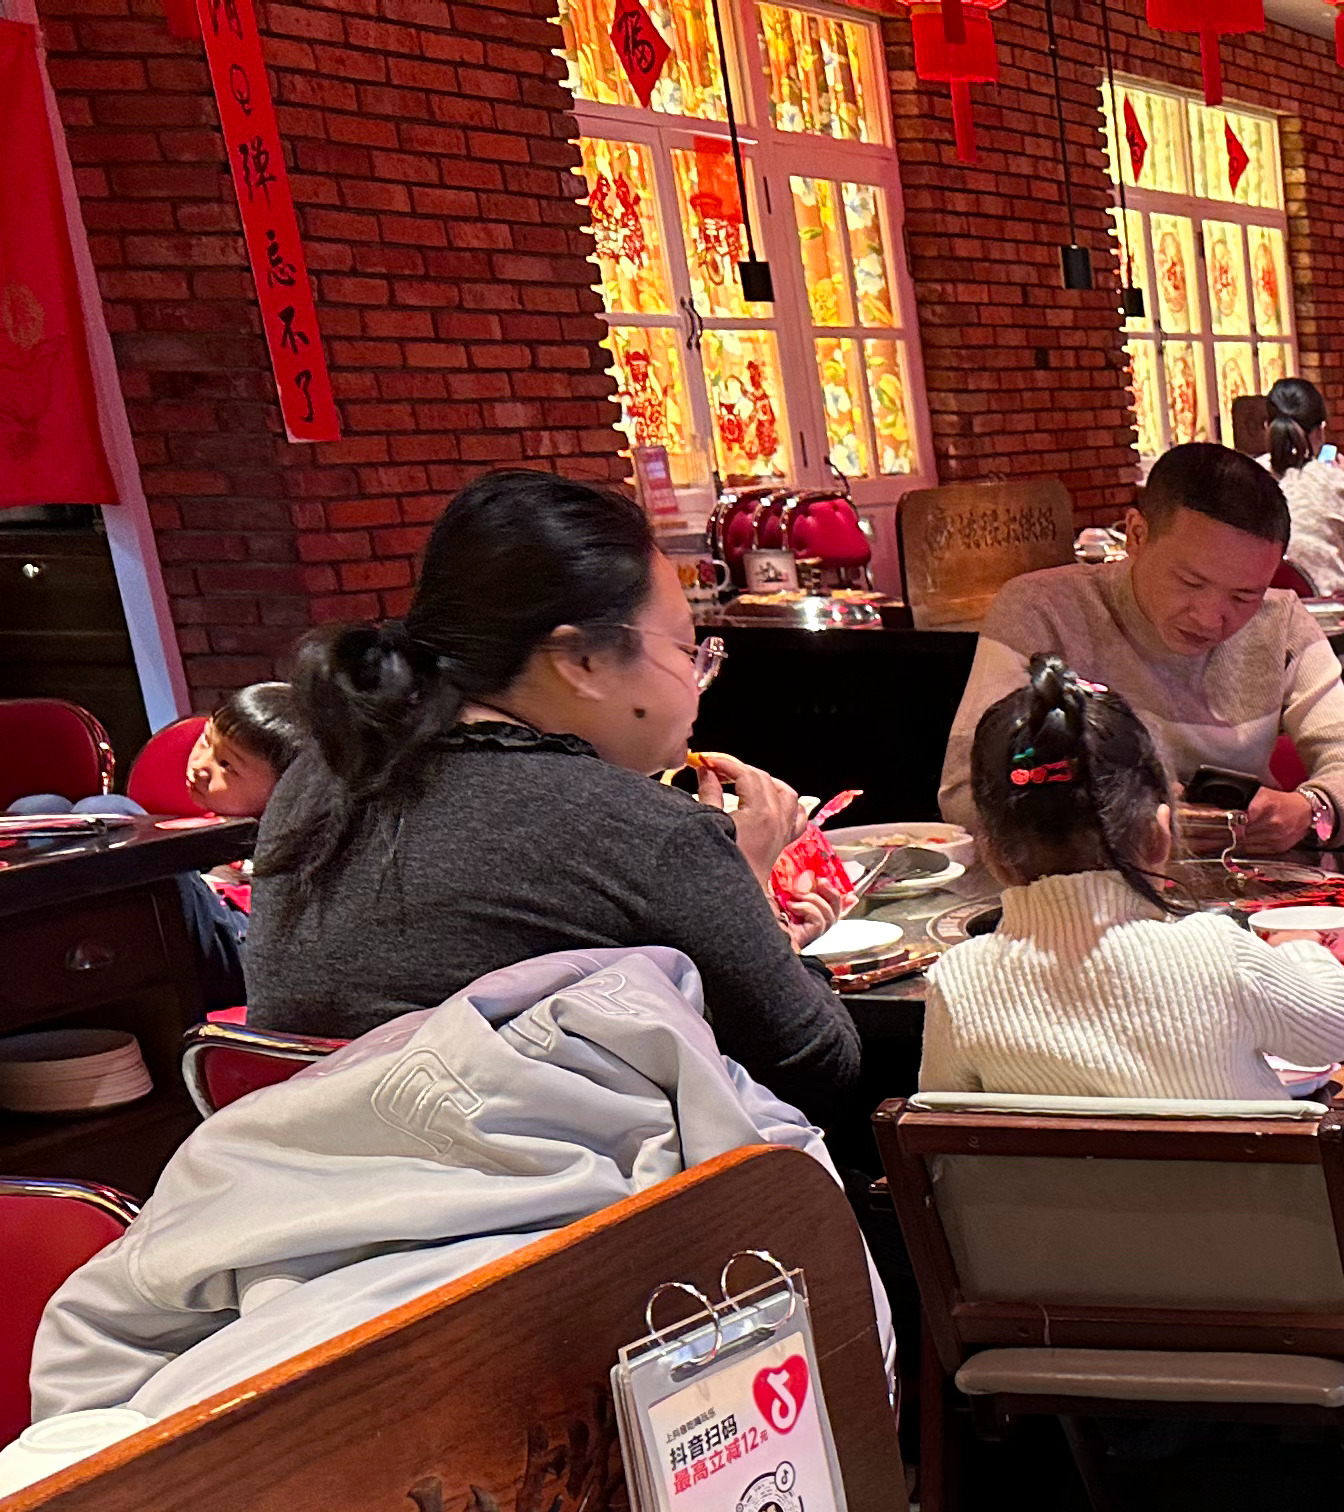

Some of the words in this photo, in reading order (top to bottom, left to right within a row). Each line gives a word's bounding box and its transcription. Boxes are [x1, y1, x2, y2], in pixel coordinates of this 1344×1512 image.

[616, 9, 656, 75] 福
[669, 1413, 738, 1472] 抖音扫码
